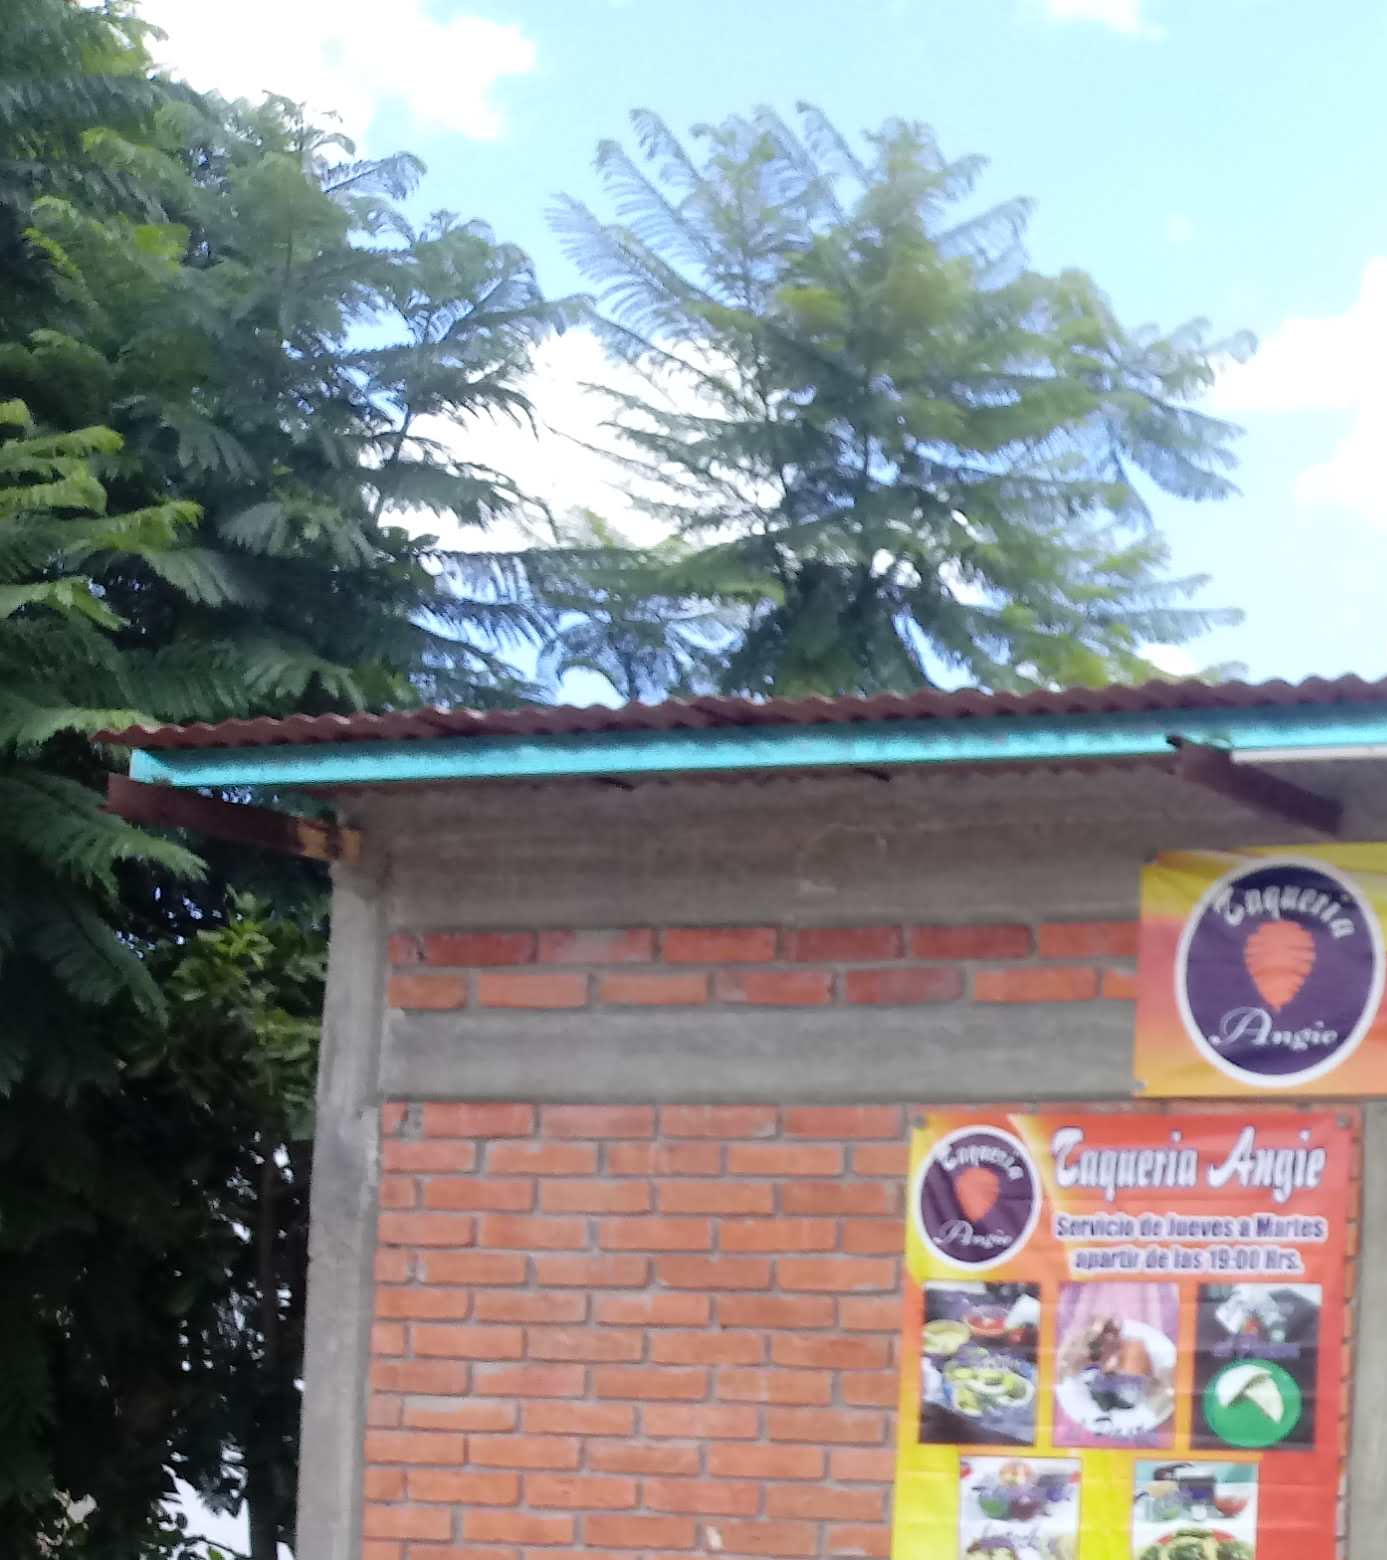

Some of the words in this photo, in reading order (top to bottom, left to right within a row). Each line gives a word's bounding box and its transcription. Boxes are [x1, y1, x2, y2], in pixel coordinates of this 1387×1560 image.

[1213, 881, 1354, 940] Taqueria
[1209, 1005, 1339, 1053] Angie
[1051, 1126, 1199, 1201] Taqueria
[1208, 1126, 1327, 1203] Angie
[1056, 1216, 1134, 1238] Servicio
[1140, 1216, 1163, 1238] de
[1238, 1221, 1250, 1238] a
[1256, 1216, 1325, 1239] Martes
[1146, 1249, 1168, 1272] de
[1208, 1248, 1263, 1273] 19:00
